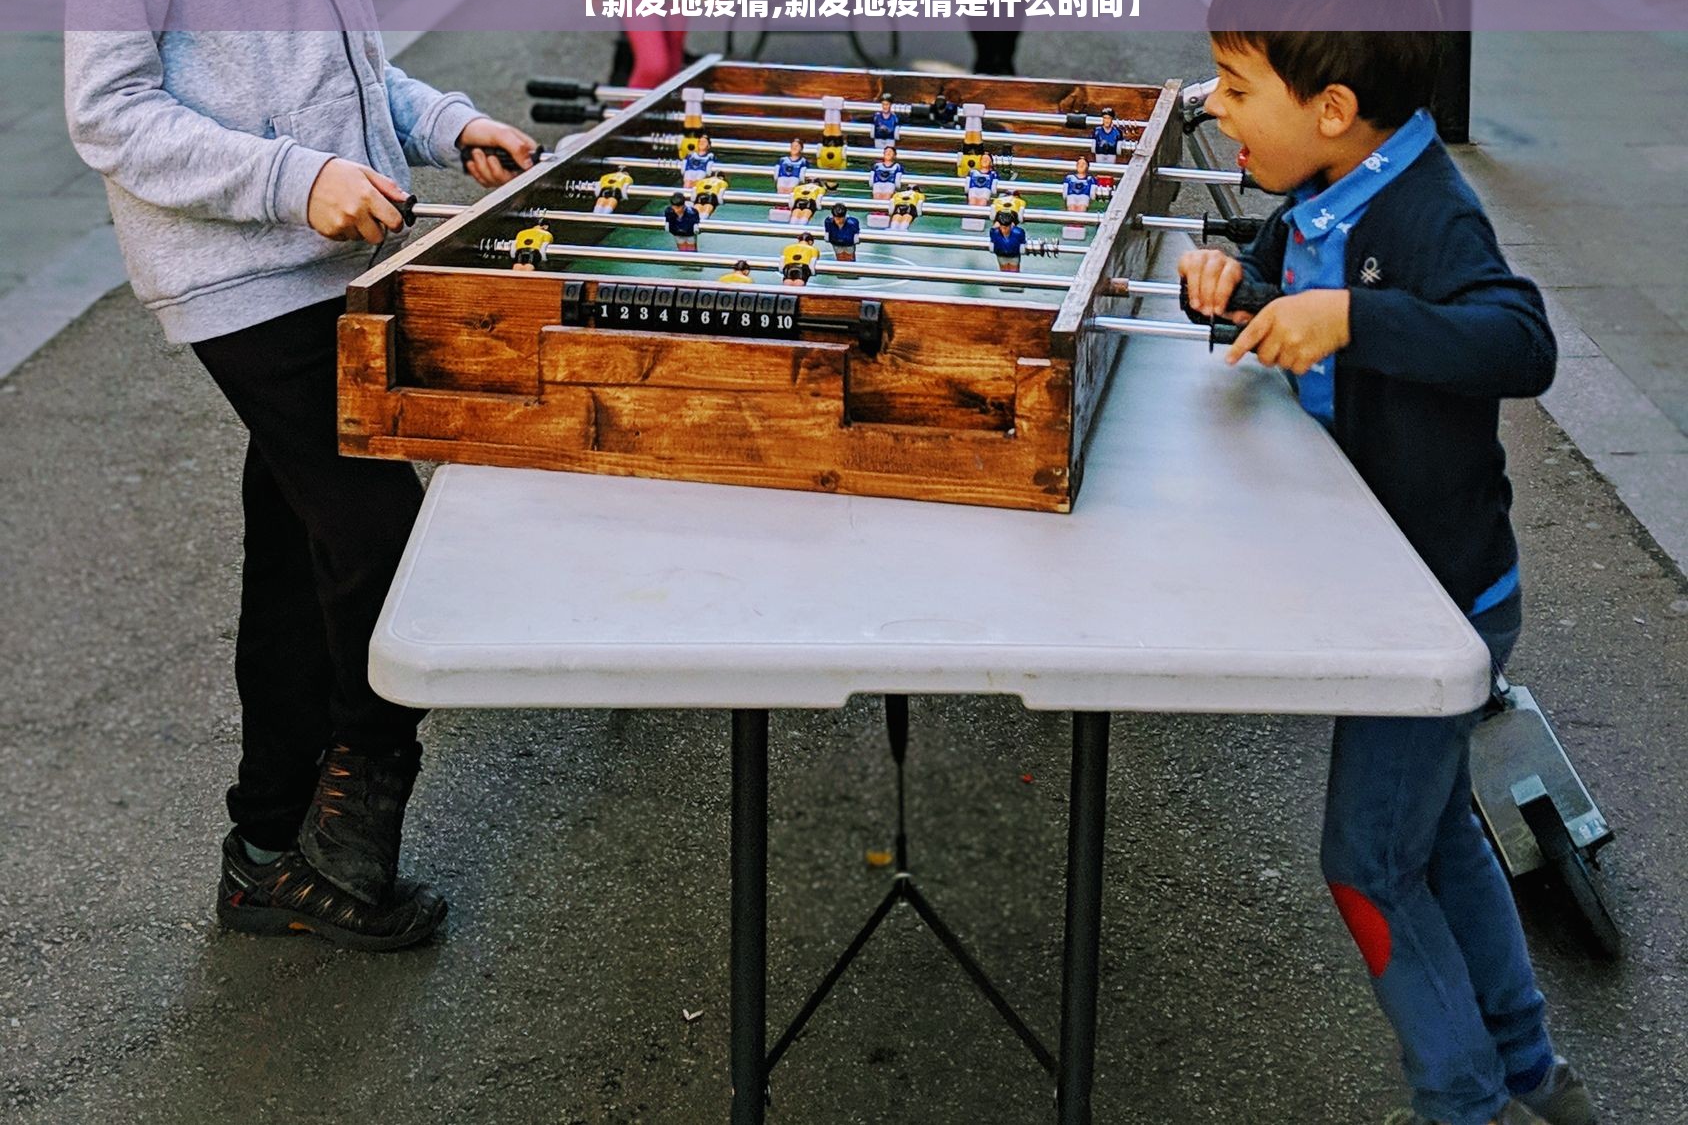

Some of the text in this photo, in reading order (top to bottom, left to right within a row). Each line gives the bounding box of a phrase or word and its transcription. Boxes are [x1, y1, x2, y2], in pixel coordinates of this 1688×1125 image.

[601, 304, 793, 329] 1 2 3 4 5 6 7 8 9 10
